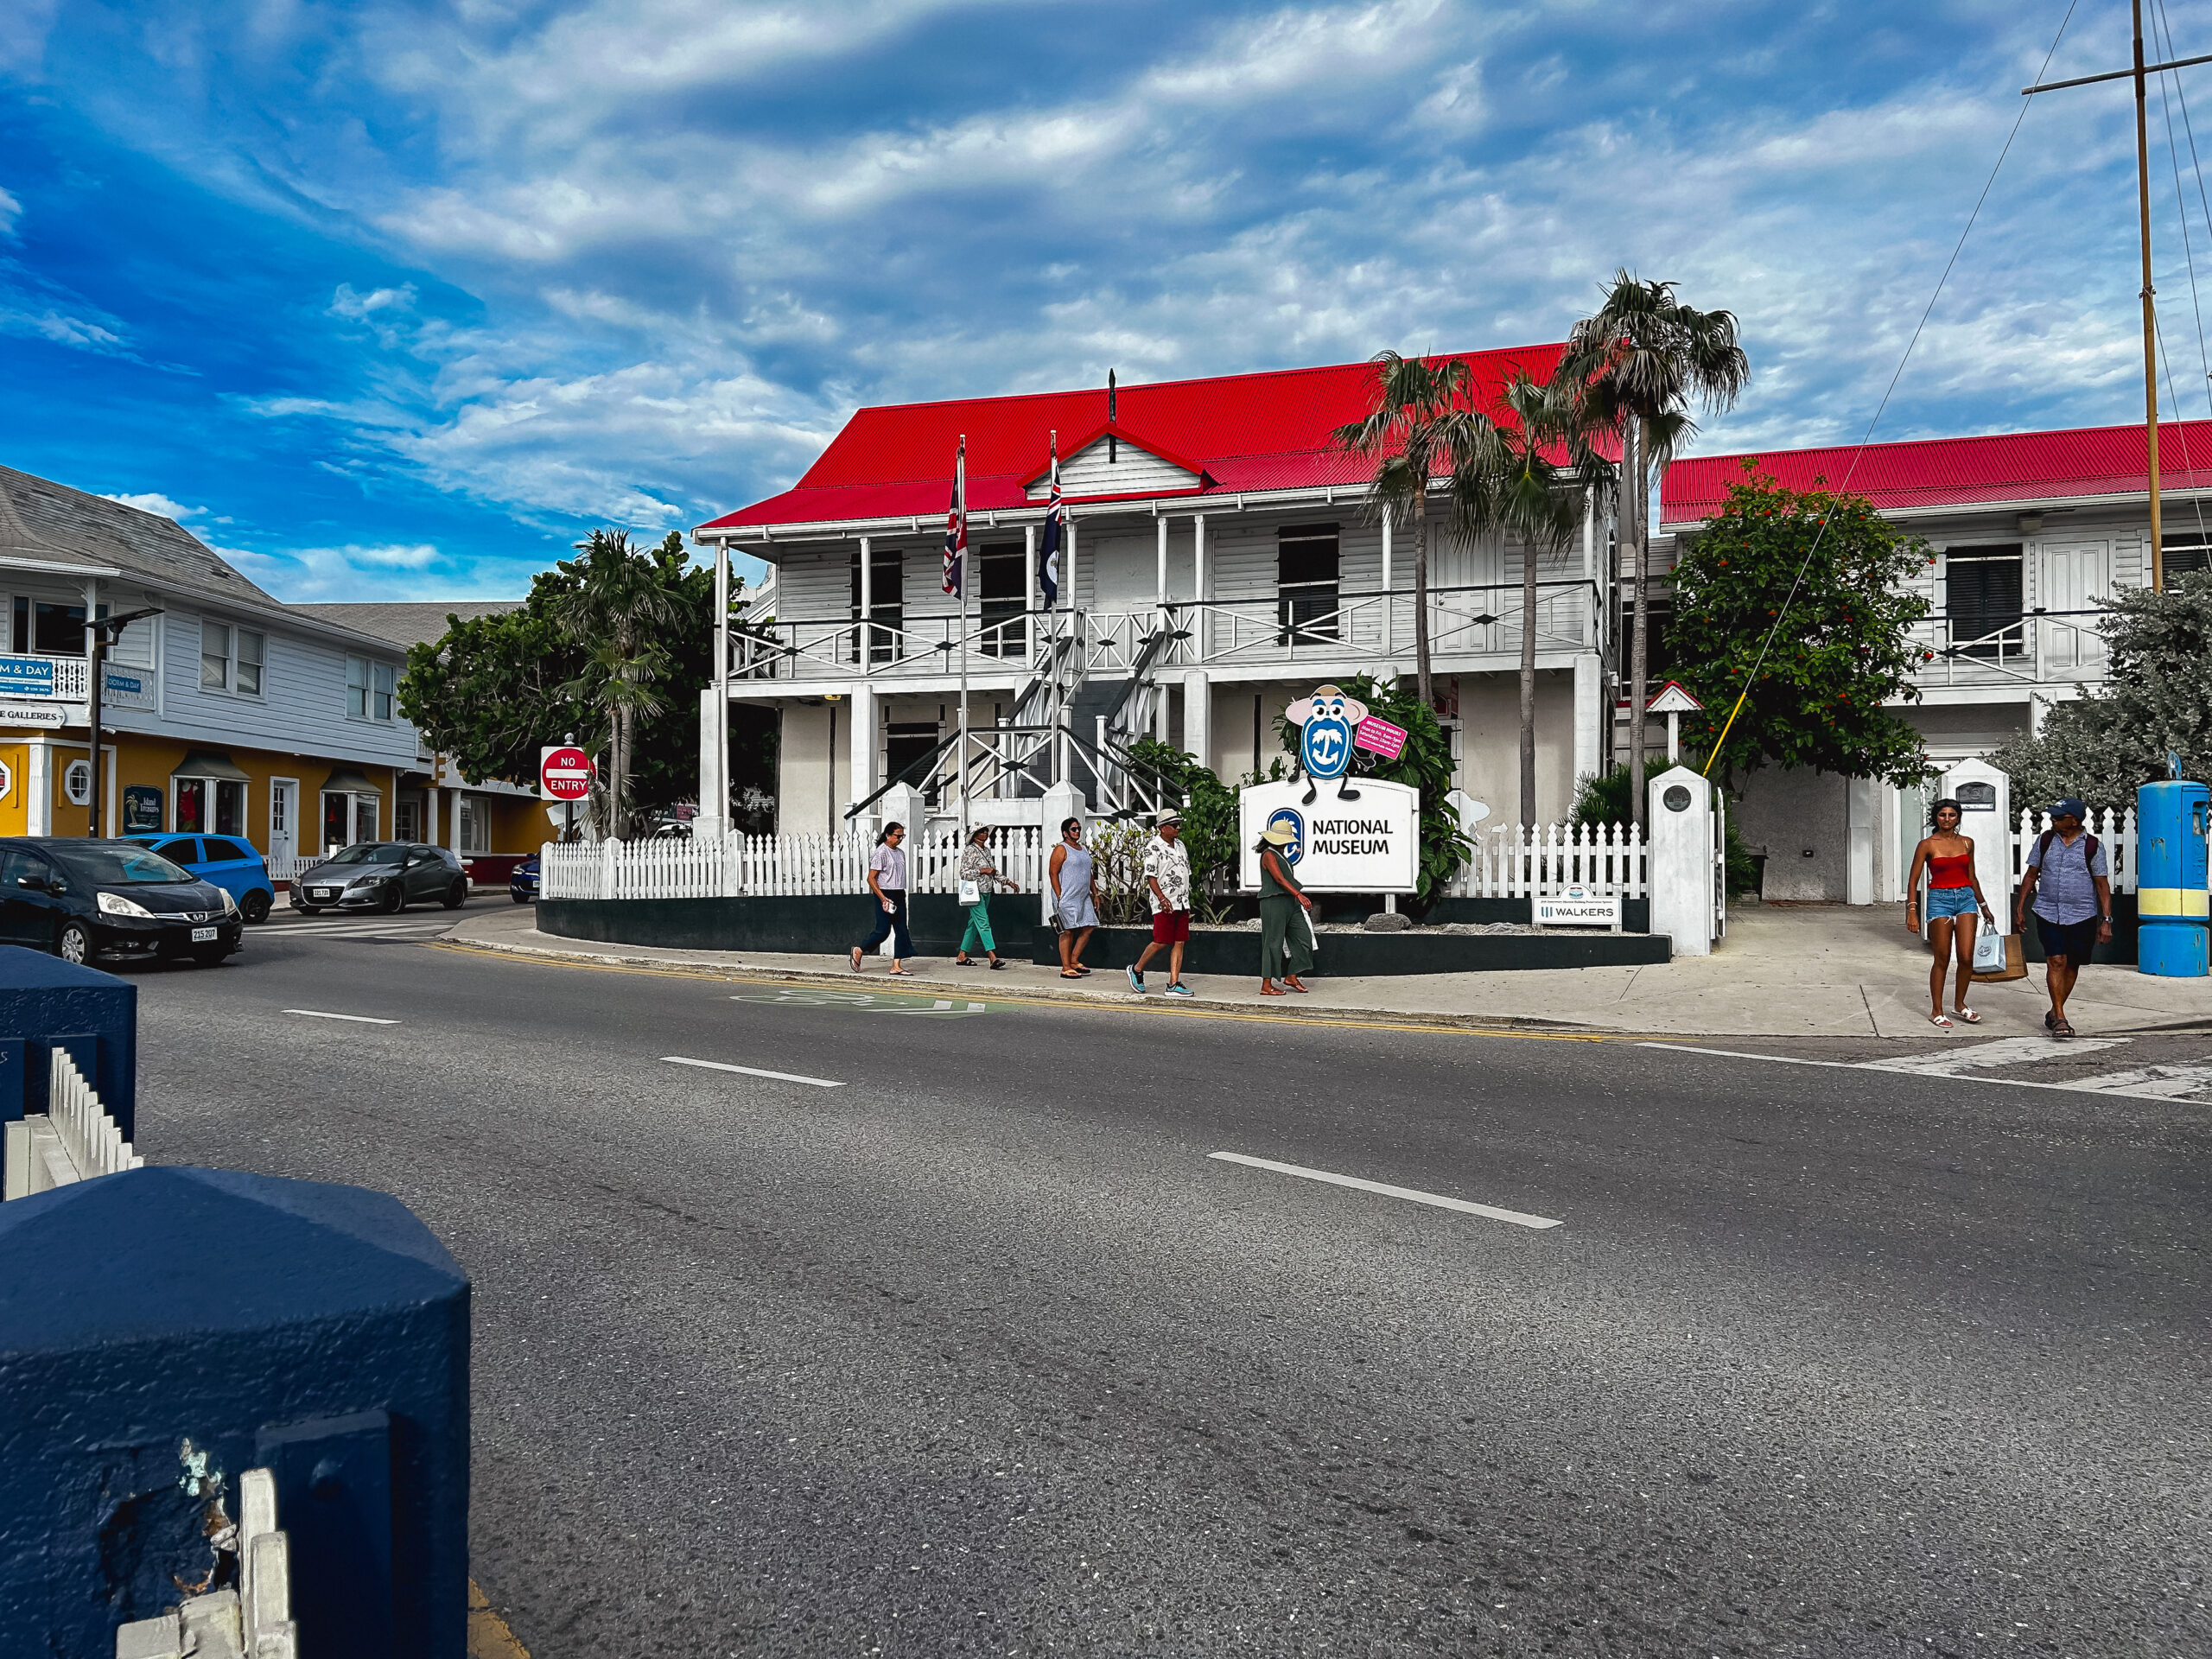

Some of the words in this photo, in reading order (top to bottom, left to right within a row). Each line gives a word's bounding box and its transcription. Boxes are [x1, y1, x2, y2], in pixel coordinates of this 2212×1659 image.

[13, 664, 22, 674] &
[26, 665, 49, 676] DAY
[130, 681, 140, 690] DAY
[7, 710, 57, 721] GALLERIES
[1366, 720, 1387, 731] MUSEUM
[1385, 727, 1402, 736] HOURS
[560, 757, 575, 767] NO
[550, 780, 588, 791] ENTRY
[1313, 819, 1394, 835] NATIONAL
[1313, 839, 1389, 855] MUSEUM
[1555, 907, 1614, 917] WALKERS
[194, 930, 205, 938] 215
[205, 929, 216, 938] 207
